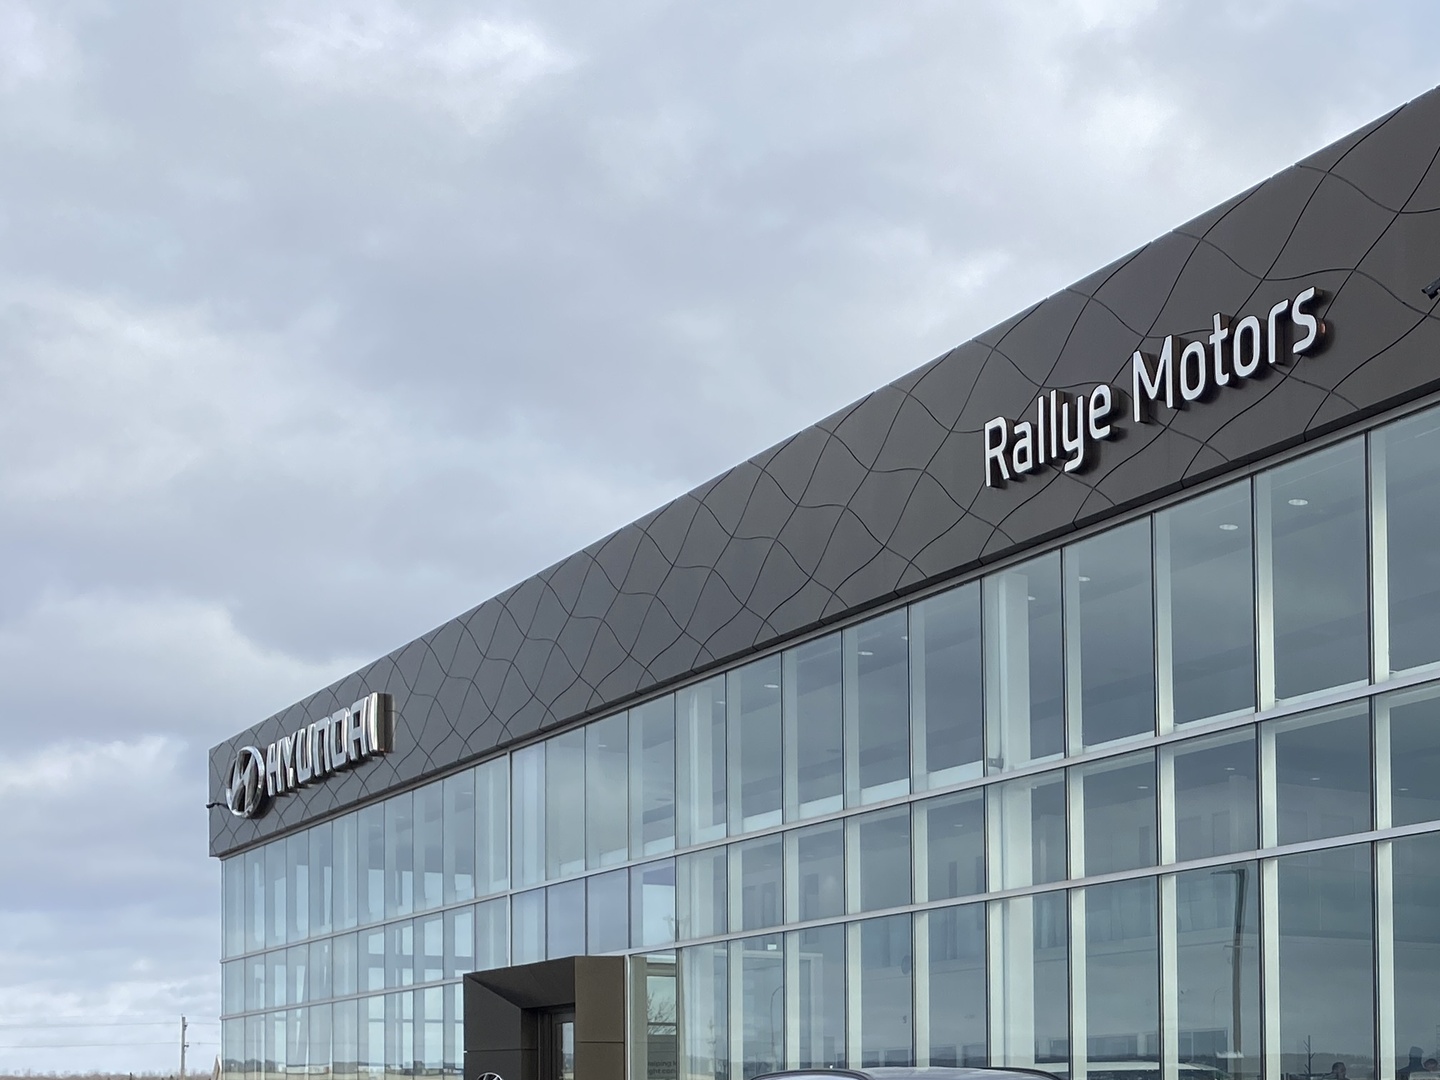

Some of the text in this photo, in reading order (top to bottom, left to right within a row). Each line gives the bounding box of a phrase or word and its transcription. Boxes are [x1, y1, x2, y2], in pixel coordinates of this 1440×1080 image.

[983, 286, 1322, 488] Rallye Motors
[265, 692, 394, 798] HYUNDAI
